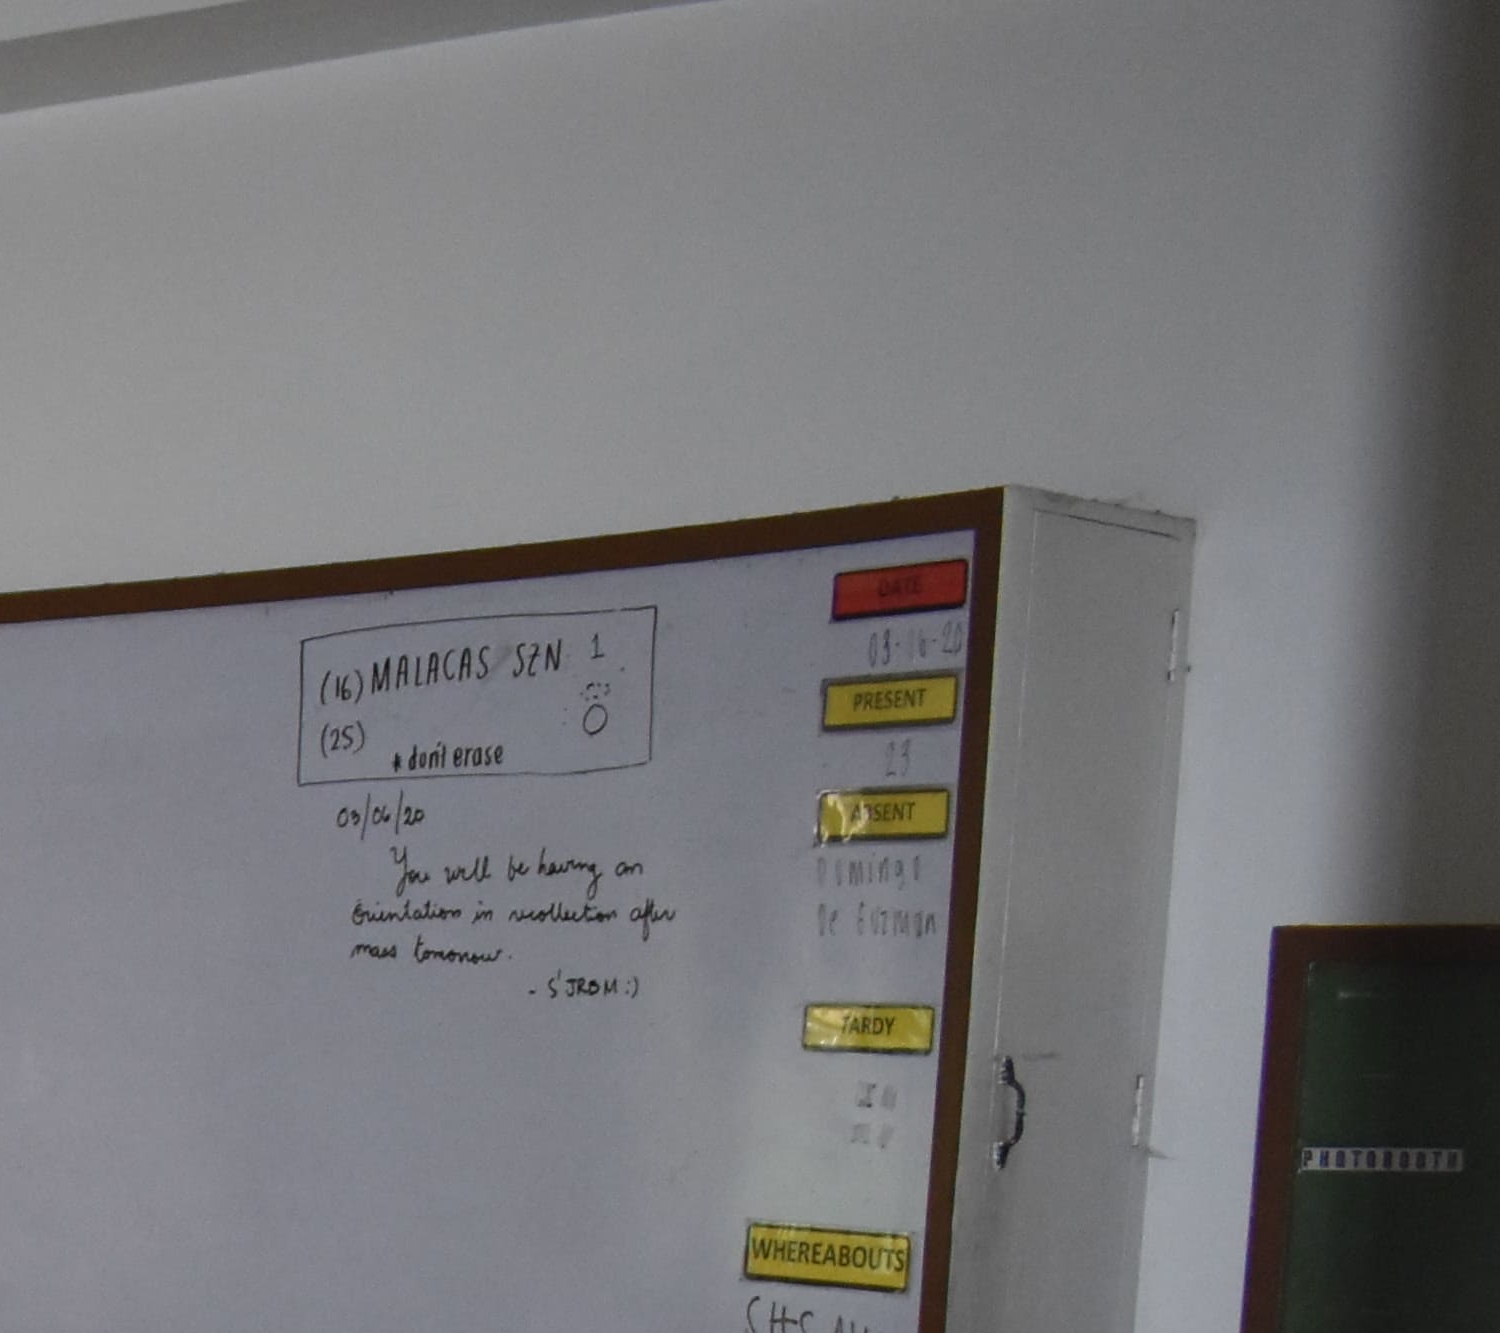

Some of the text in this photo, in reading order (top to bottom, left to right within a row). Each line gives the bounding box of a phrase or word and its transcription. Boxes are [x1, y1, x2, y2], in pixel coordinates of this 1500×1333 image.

[877, 575, 923, 598] DATE
[320, 669, 364, 704] (16)
[371, 646, 489, 695] MALACAS
[853, 688, 927, 711] PRESENT
[320, 721, 365, 758] (25)
[452, 744, 504, 767] erase
[850, 802, 915, 822] ABSENT
[390, 846, 643, 900] You will be having an
[508, 902, 618, 924] recollection
[630, 898, 676, 942] after
[350, 941, 398, 960] mass
[841, 1016, 896, 1036] TARDY
[751, 1237, 905, 1273] WHEREABOUTS
